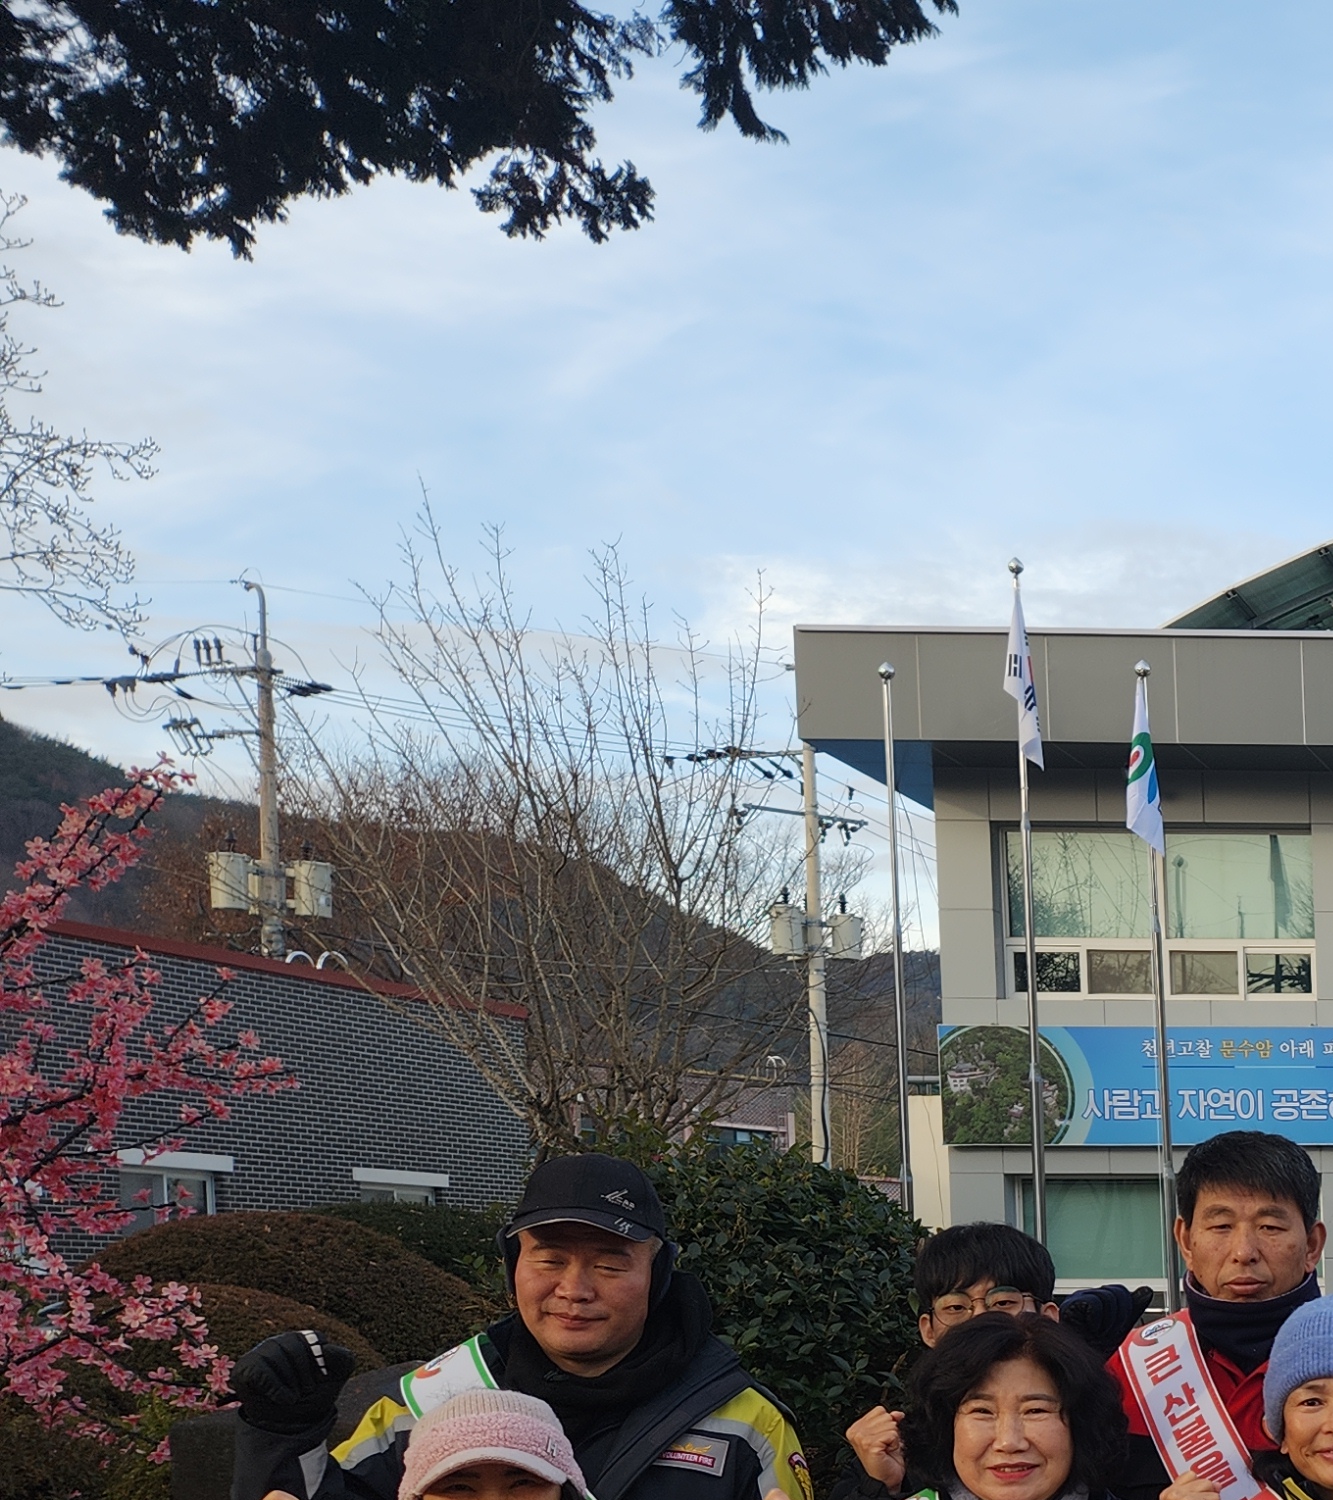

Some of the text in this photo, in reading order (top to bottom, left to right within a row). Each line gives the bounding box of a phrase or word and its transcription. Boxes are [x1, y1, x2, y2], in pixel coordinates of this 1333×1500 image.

[1219, 1039, 1273, 1059] 문수암
[1280, 1038, 1315, 1059] 아래
[1177, 1088, 1264, 1121] 자연이
[1144, 1343, 1183, 1386] 큰
